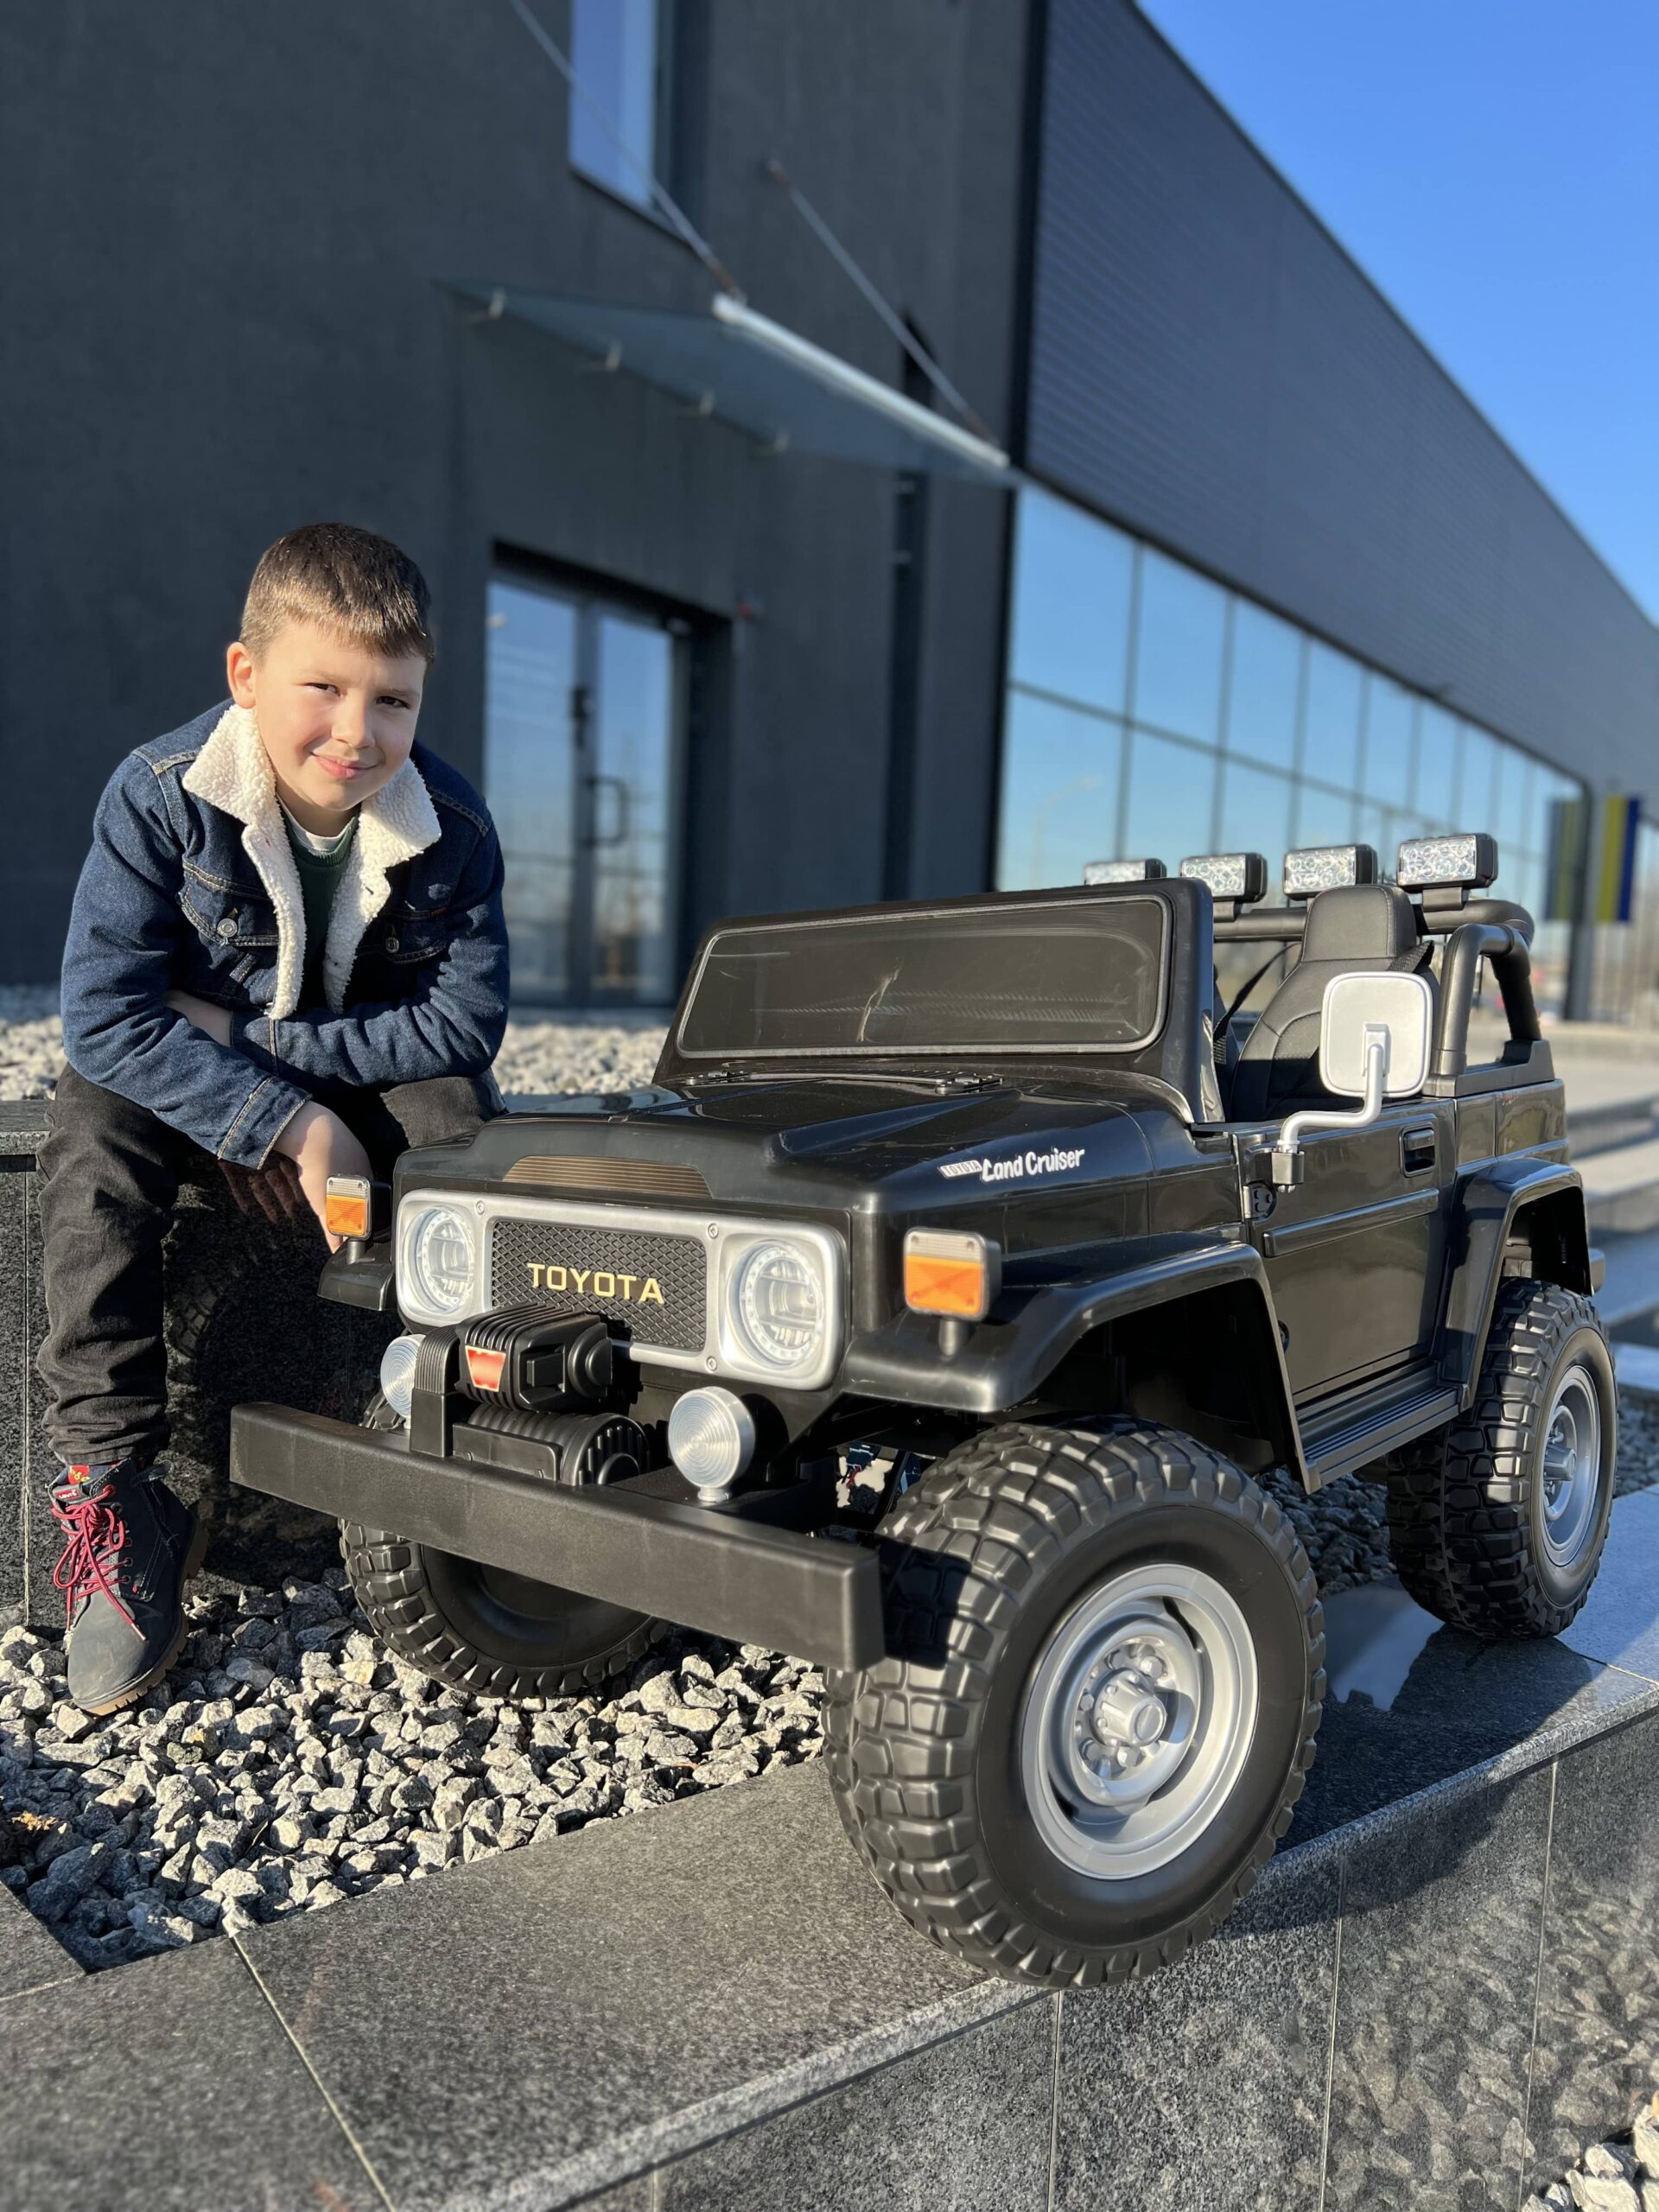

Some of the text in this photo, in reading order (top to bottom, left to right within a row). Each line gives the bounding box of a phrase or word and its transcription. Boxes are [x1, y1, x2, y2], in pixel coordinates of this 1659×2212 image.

[941, 1147, 1085, 1182] TOYOTA Land Cruiser
[527, 1262, 664, 1305] TOYOTA
